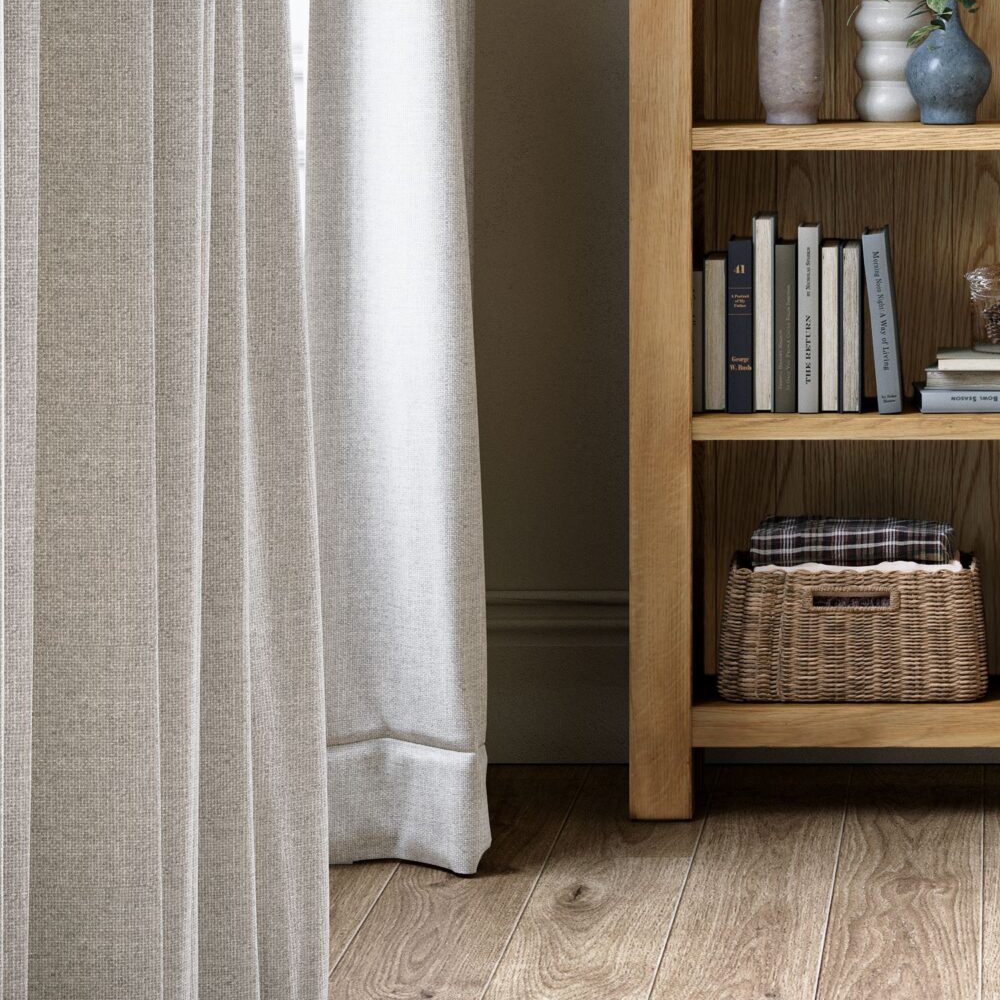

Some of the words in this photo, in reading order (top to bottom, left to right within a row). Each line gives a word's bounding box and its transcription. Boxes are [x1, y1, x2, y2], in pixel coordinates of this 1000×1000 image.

[872, 251, 881, 277] Morning
[874, 278, 883, 292] Noon
[879, 320, 888, 336] Way
[882, 347, 890, 371] Living
